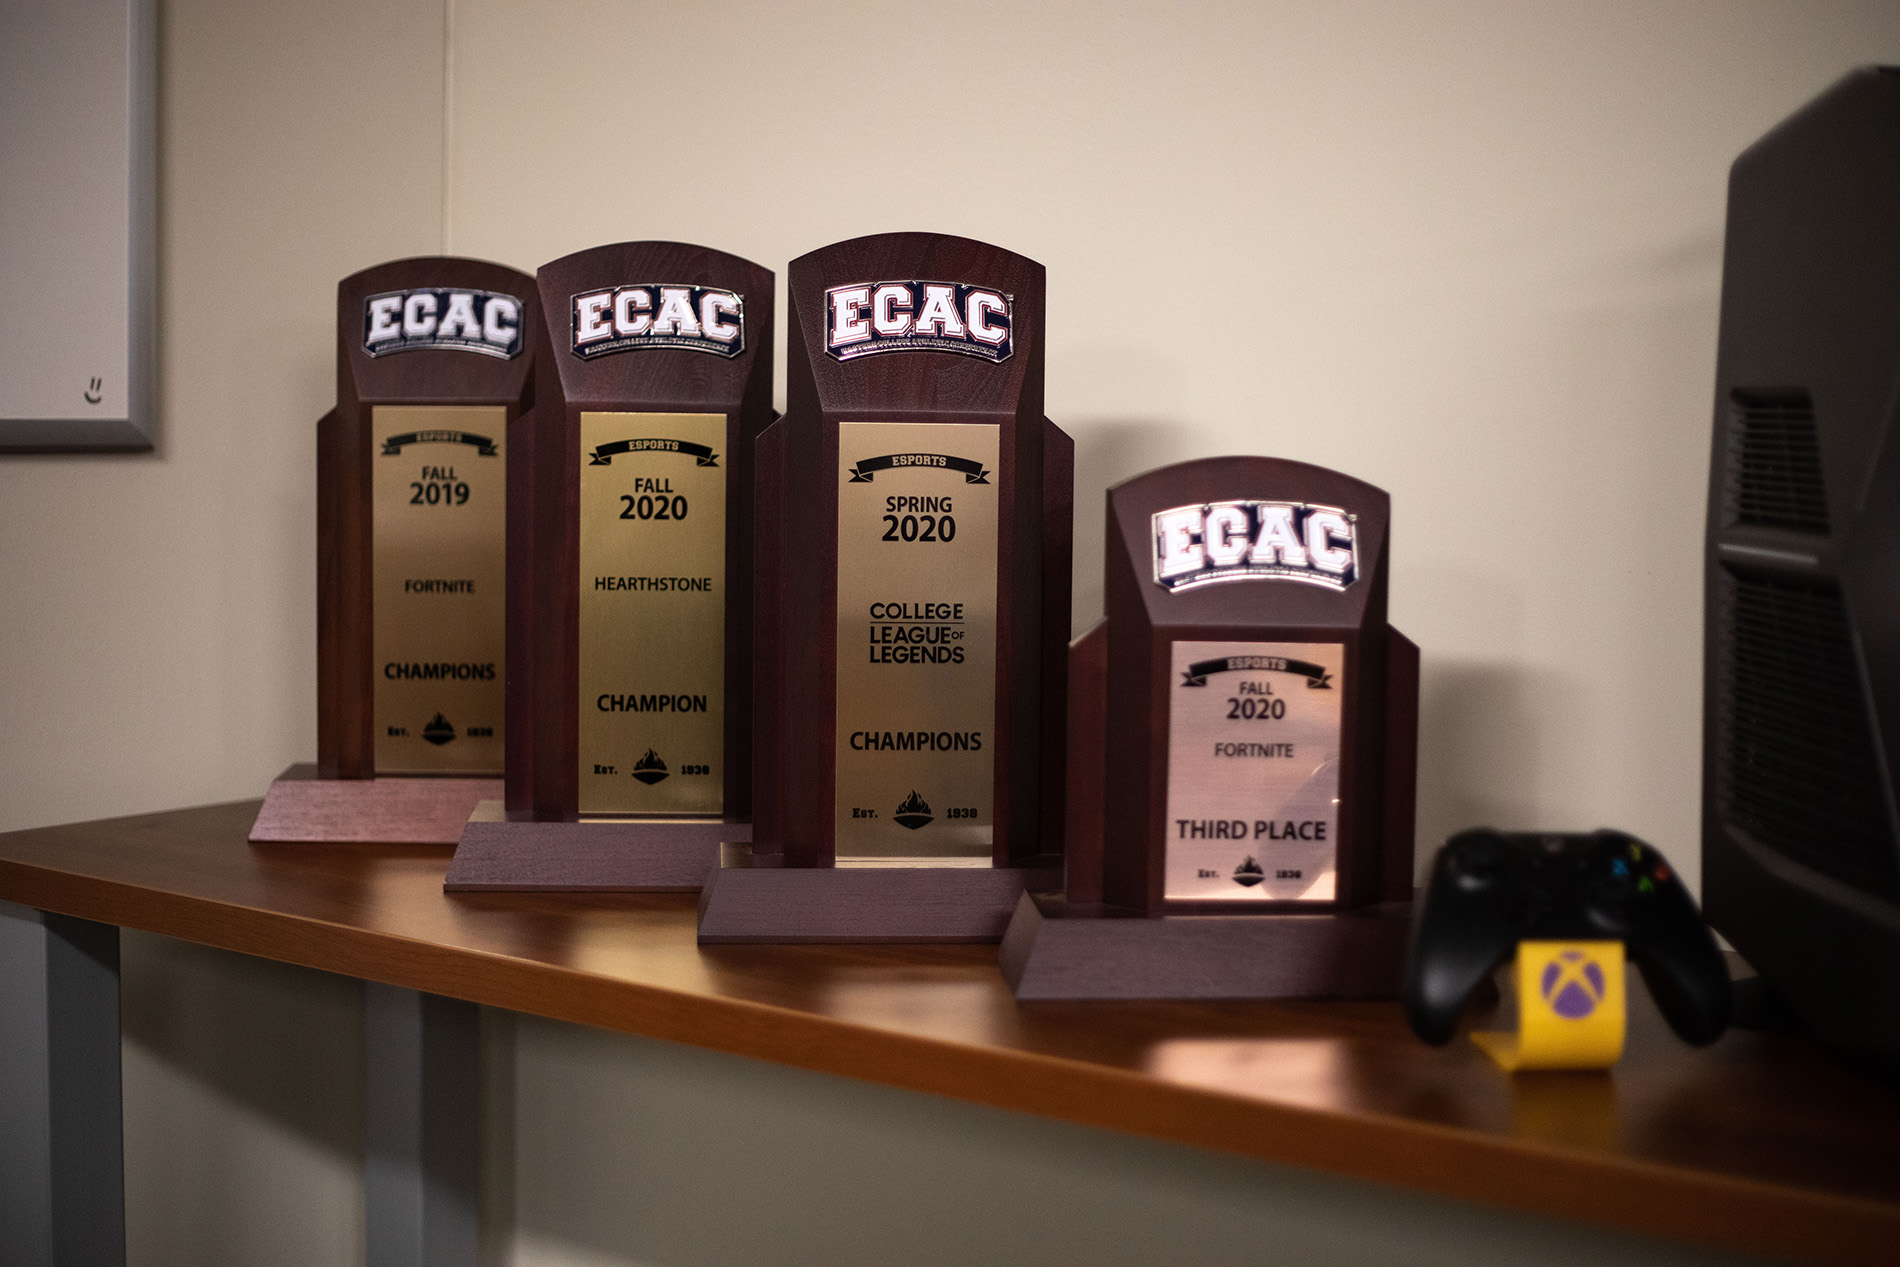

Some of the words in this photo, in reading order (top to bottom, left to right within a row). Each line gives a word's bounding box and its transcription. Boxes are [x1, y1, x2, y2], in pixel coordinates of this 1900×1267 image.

[366, 293, 519, 347] ECAC
[575, 287, 739, 346] ECAC
[829, 284, 1008, 347] ECAC
[628, 440, 680, 451] ESPORTS
[892, 455, 947, 467] ESPORTS
[422, 466, 457, 480] FALL
[409, 482, 470, 505] 2019
[635, 478, 674, 493] FALL
[619, 494, 689, 521] 2020
[886, 496, 952, 513] SPRING
[881, 514, 956, 543] 2020
[1158, 504, 1353, 579] ECAC
[404, 579, 475, 594] FORTNITE
[594, 576, 712, 592] HEARTHSTONE
[869, 602, 964, 620] COLLEGE
[869, 626, 951, 644] LEAGUE
[951, 631, 965, 640] OF
[869, 645, 965, 664] LEGENDS
[1226, 657, 1288, 671] ESPORTS
[384, 662, 497, 681] CHAMPIONS
[1239, 681, 1273, 696] FALL
[597, 694, 708, 713] CHAMPION
[1226, 697, 1286, 720] 2020
[850, 731, 983, 752] CHAMPIONS
[1214, 742, 1295, 758] FORTNITE
[1176, 819, 1248, 840] THIRD
[1254, 820, 1327, 841] PLACE
